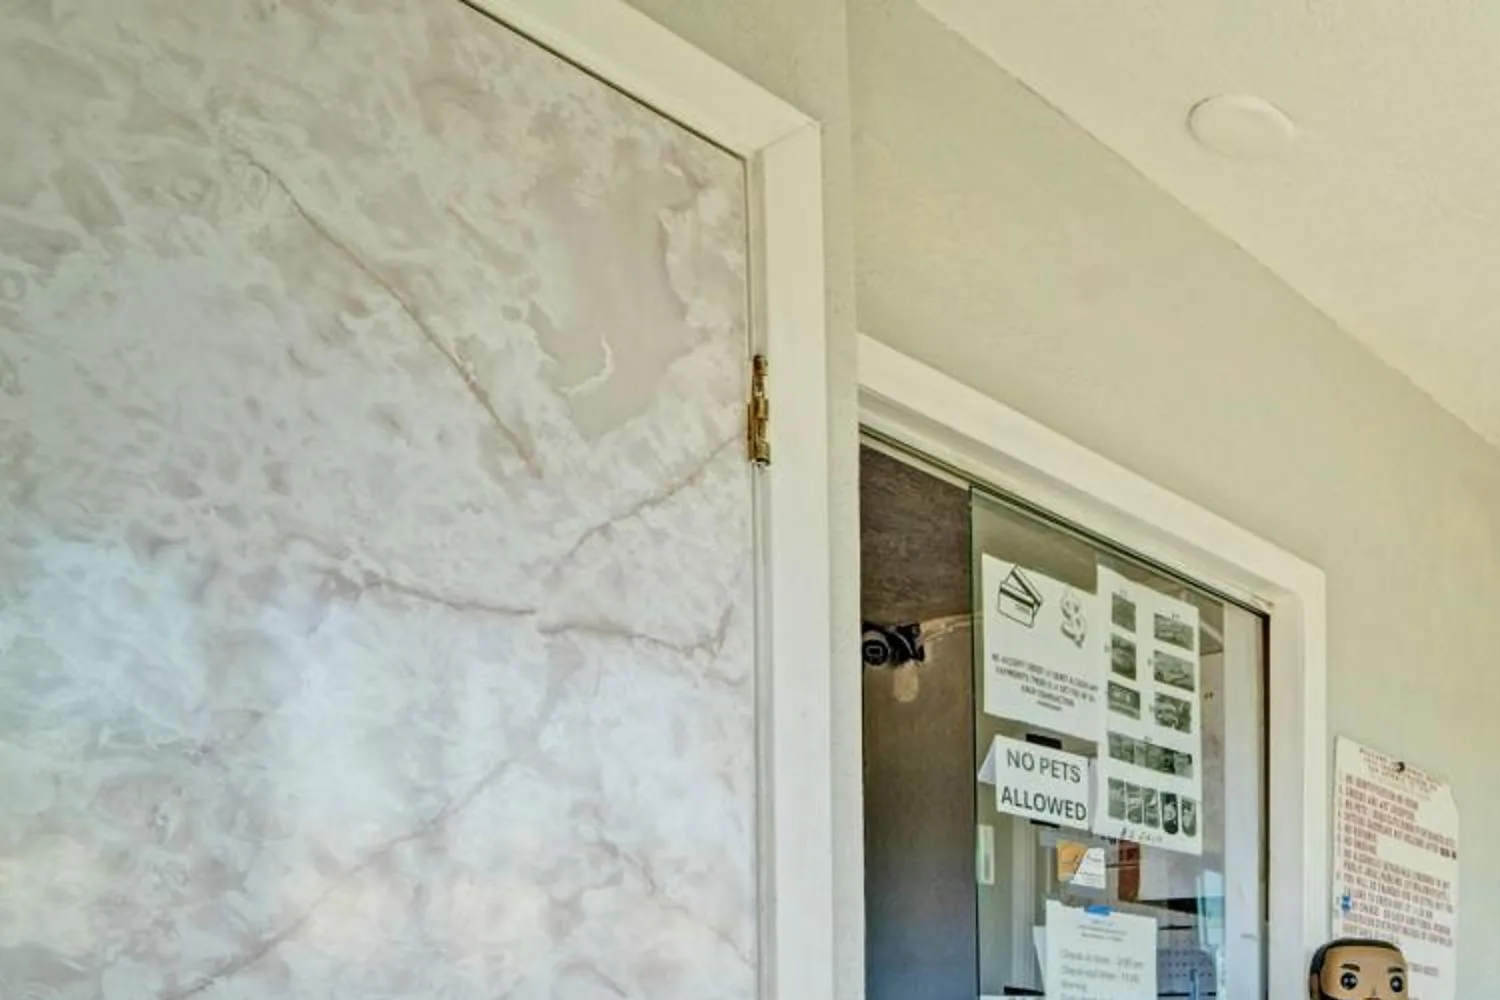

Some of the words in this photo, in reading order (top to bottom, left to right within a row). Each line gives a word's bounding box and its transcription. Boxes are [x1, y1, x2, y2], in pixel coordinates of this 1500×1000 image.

[1007, 748, 1035, 771] NO
[1040, 757, 1081, 783] PETS
[1001, 786, 1087, 820] ALLOWED
